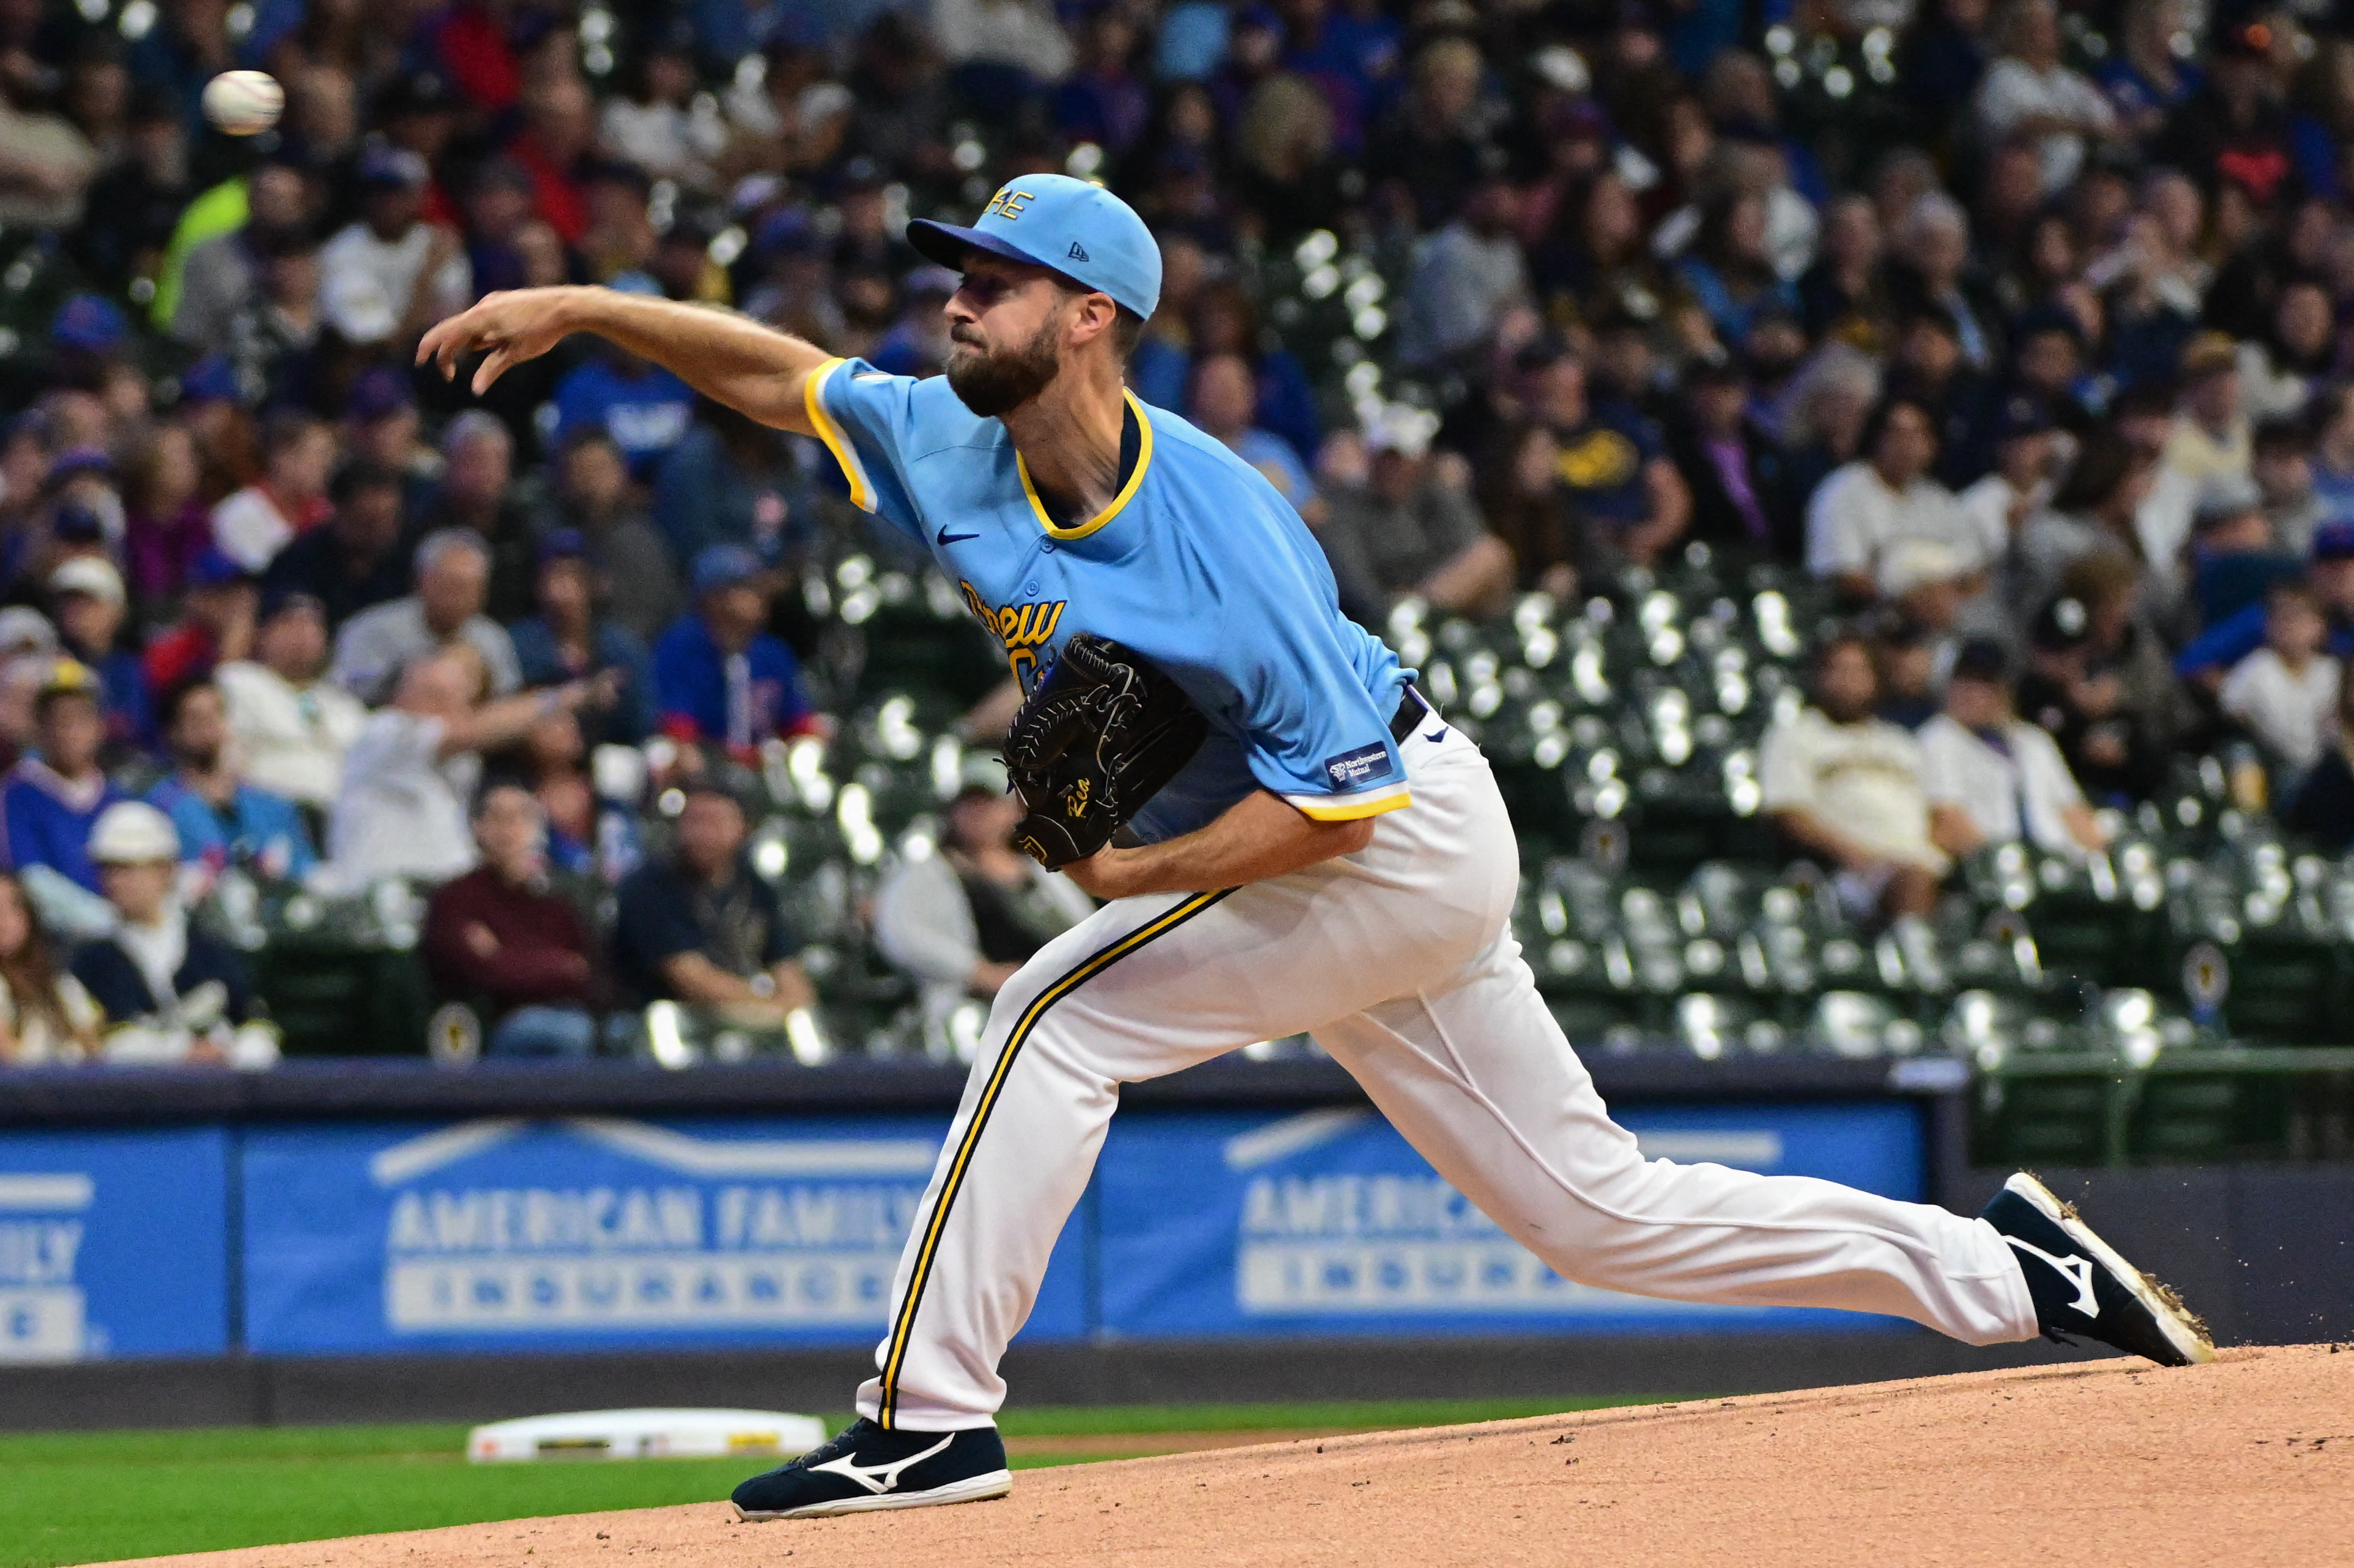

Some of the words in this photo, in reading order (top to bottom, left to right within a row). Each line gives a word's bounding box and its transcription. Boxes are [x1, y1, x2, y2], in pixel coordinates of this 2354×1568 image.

[1345, 751, 1387, 769] Northwestern
[1348, 764, 1370, 777] Mutual
[1067, 777, 1091, 818] Rea
[388, 1186, 703, 1248] AMERICAN
